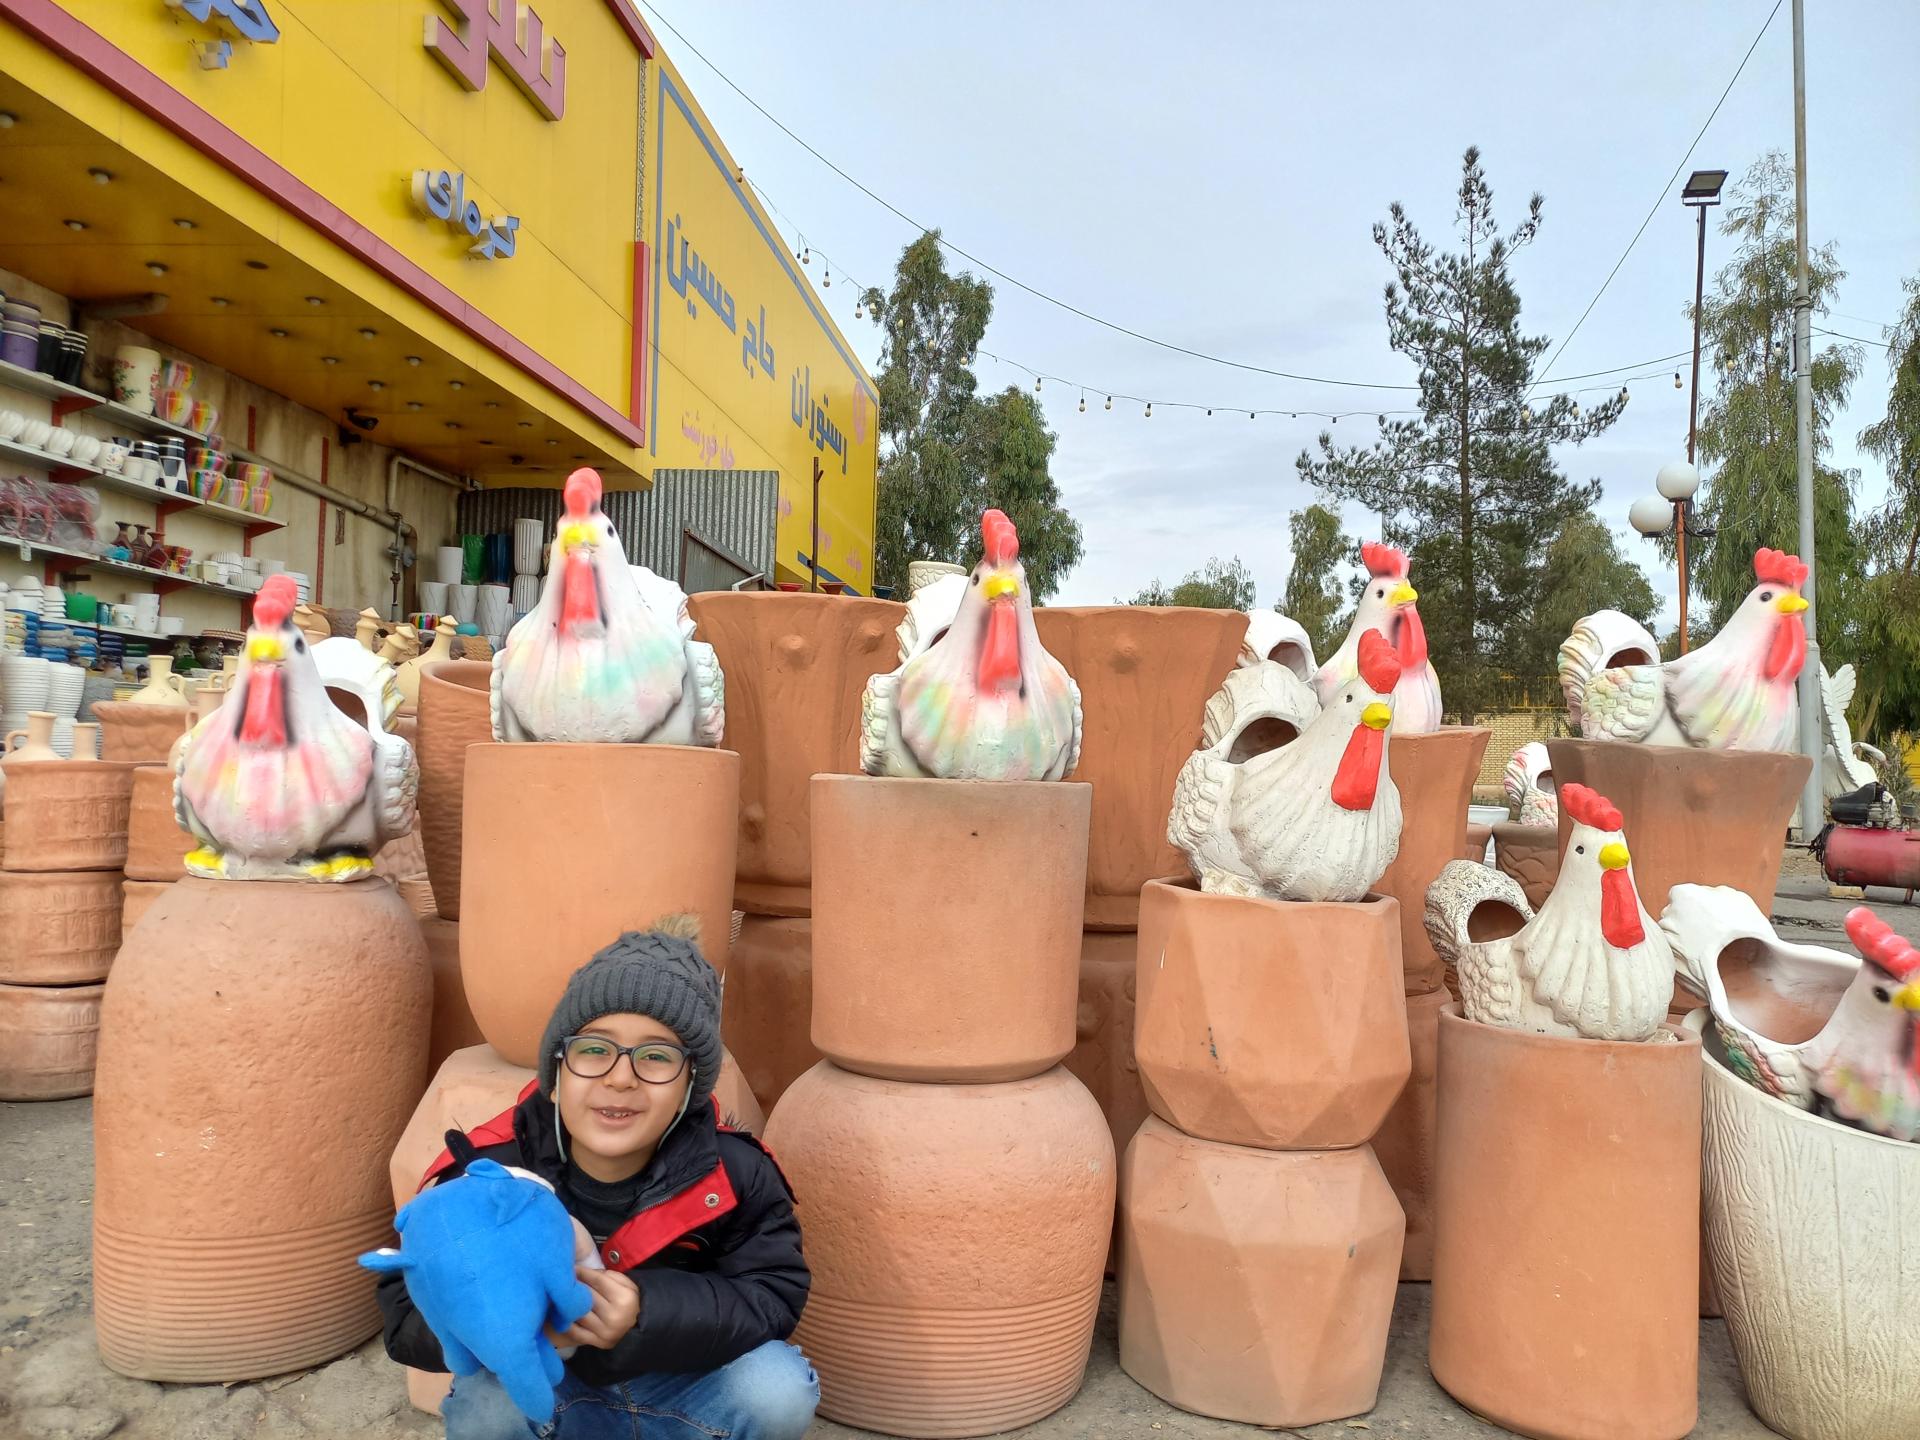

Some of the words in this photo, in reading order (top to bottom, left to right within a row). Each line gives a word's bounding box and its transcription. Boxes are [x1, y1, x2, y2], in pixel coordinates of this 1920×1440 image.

[667, 213, 736, 335] حسین
[742, 304, 775, 380] حاج
[791, 365, 847, 475] رستوران
